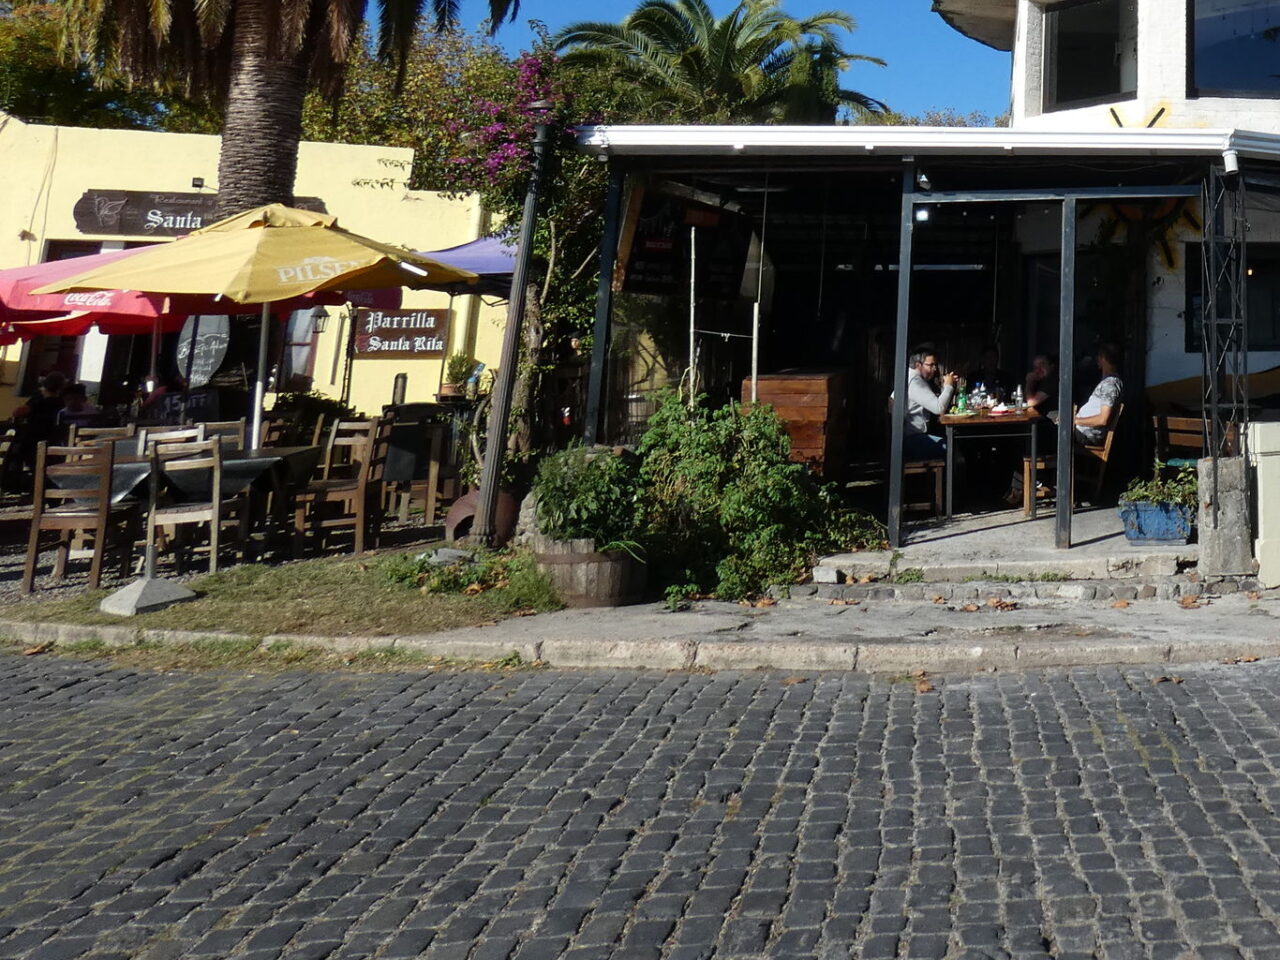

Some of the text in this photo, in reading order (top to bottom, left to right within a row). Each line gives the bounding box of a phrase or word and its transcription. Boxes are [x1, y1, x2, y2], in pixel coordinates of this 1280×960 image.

[144, 209, 202, 231] Santa
[366, 311, 436, 333] Parrilla
[367, 336, 410, 353] Santa
